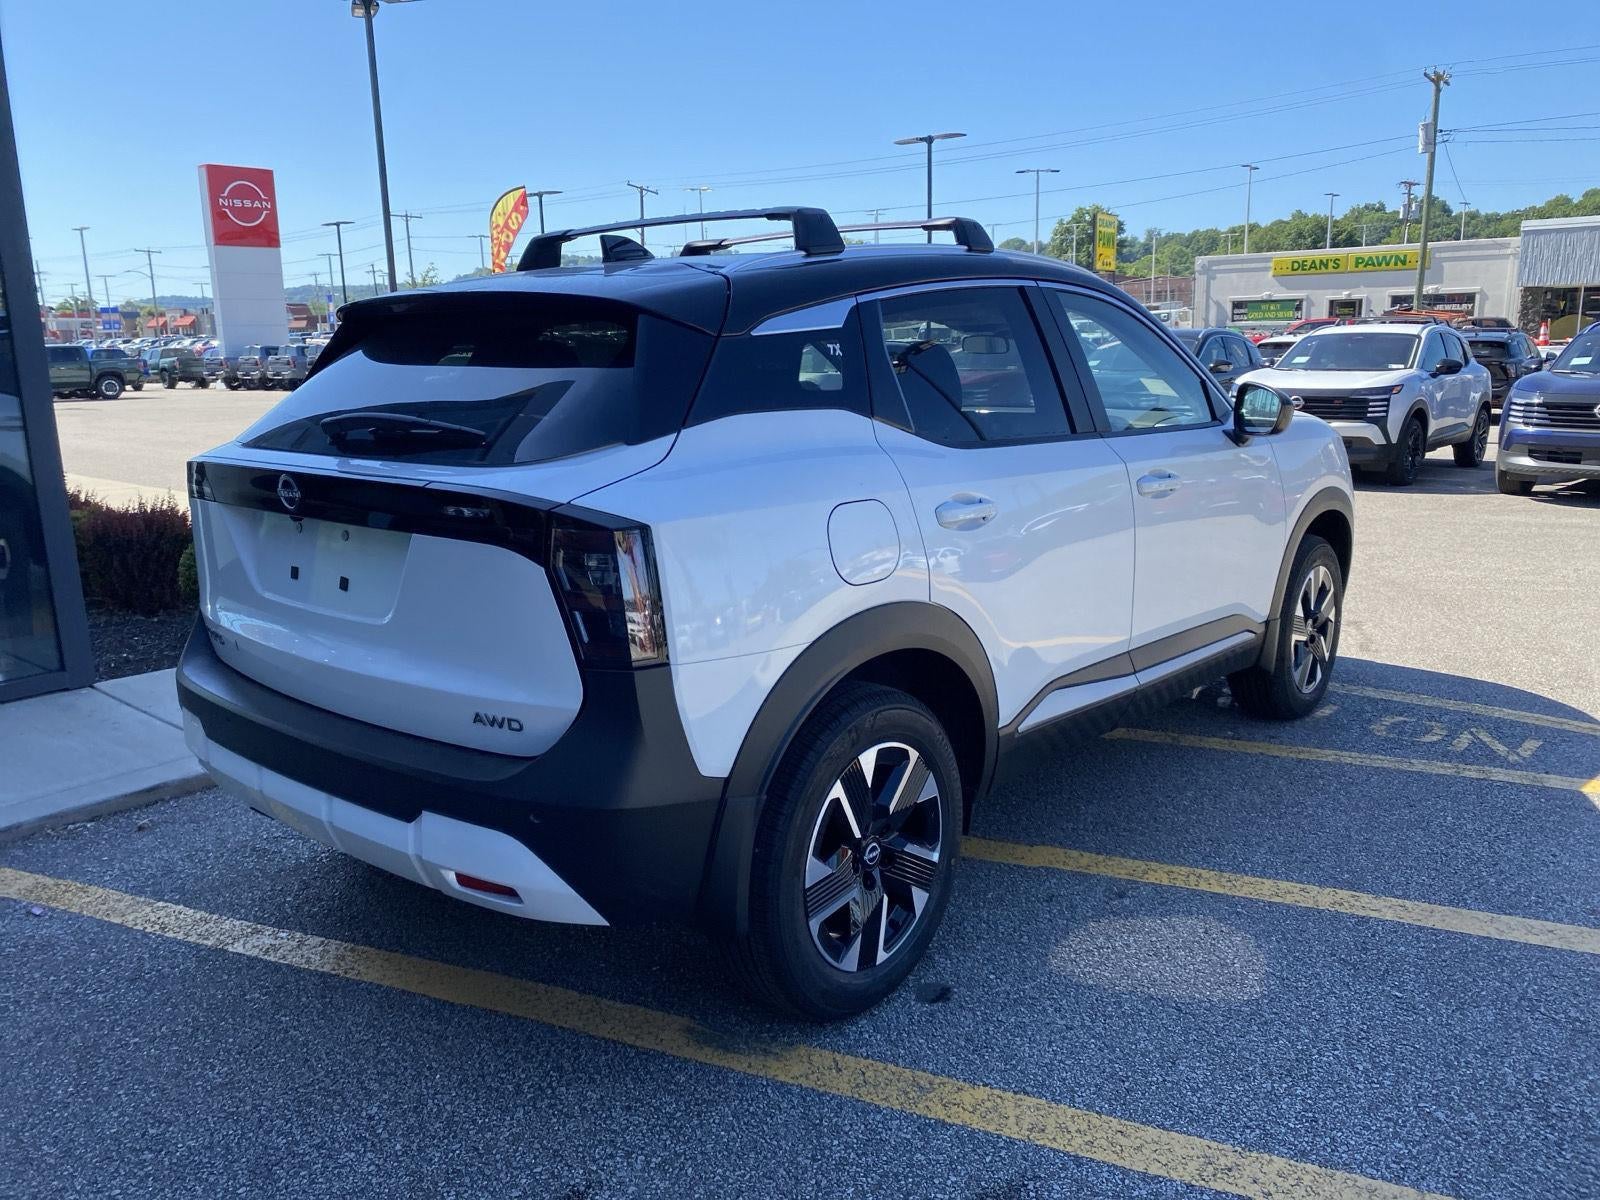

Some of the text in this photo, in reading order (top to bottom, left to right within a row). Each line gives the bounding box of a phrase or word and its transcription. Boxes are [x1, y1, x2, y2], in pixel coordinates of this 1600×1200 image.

[218, 198, 271, 209] NISSAN
[1291, 254, 1408, 272] DEAN'S PAWN
[1434, 303, 1474, 311] JEWELRY
[1248, 311, 1263, 319] GOLD
[1264, 311, 1276, 319] AND
[826, 343, 843, 357] TX
[472, 711, 524, 733] AWD
